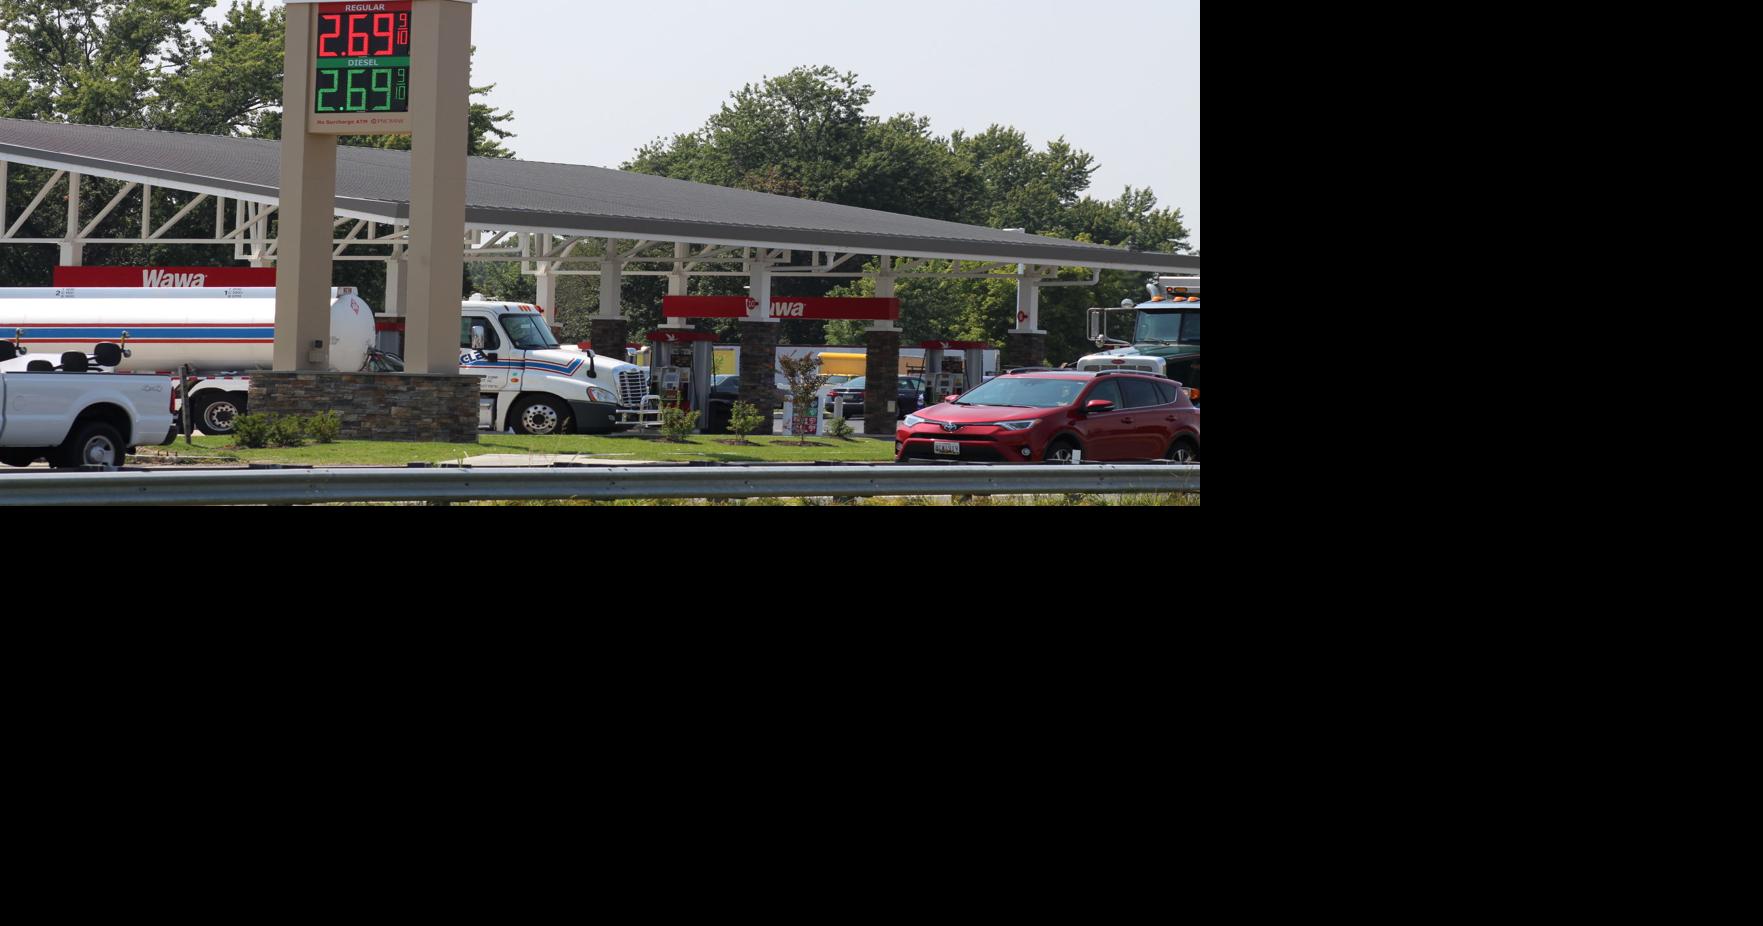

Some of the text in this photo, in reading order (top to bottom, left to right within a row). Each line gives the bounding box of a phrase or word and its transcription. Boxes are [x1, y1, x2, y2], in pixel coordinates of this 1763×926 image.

[319, 13, 394, 56] 2.69
[318, 69, 391, 111] 2.69
[142, 269, 205, 287] Wawa
